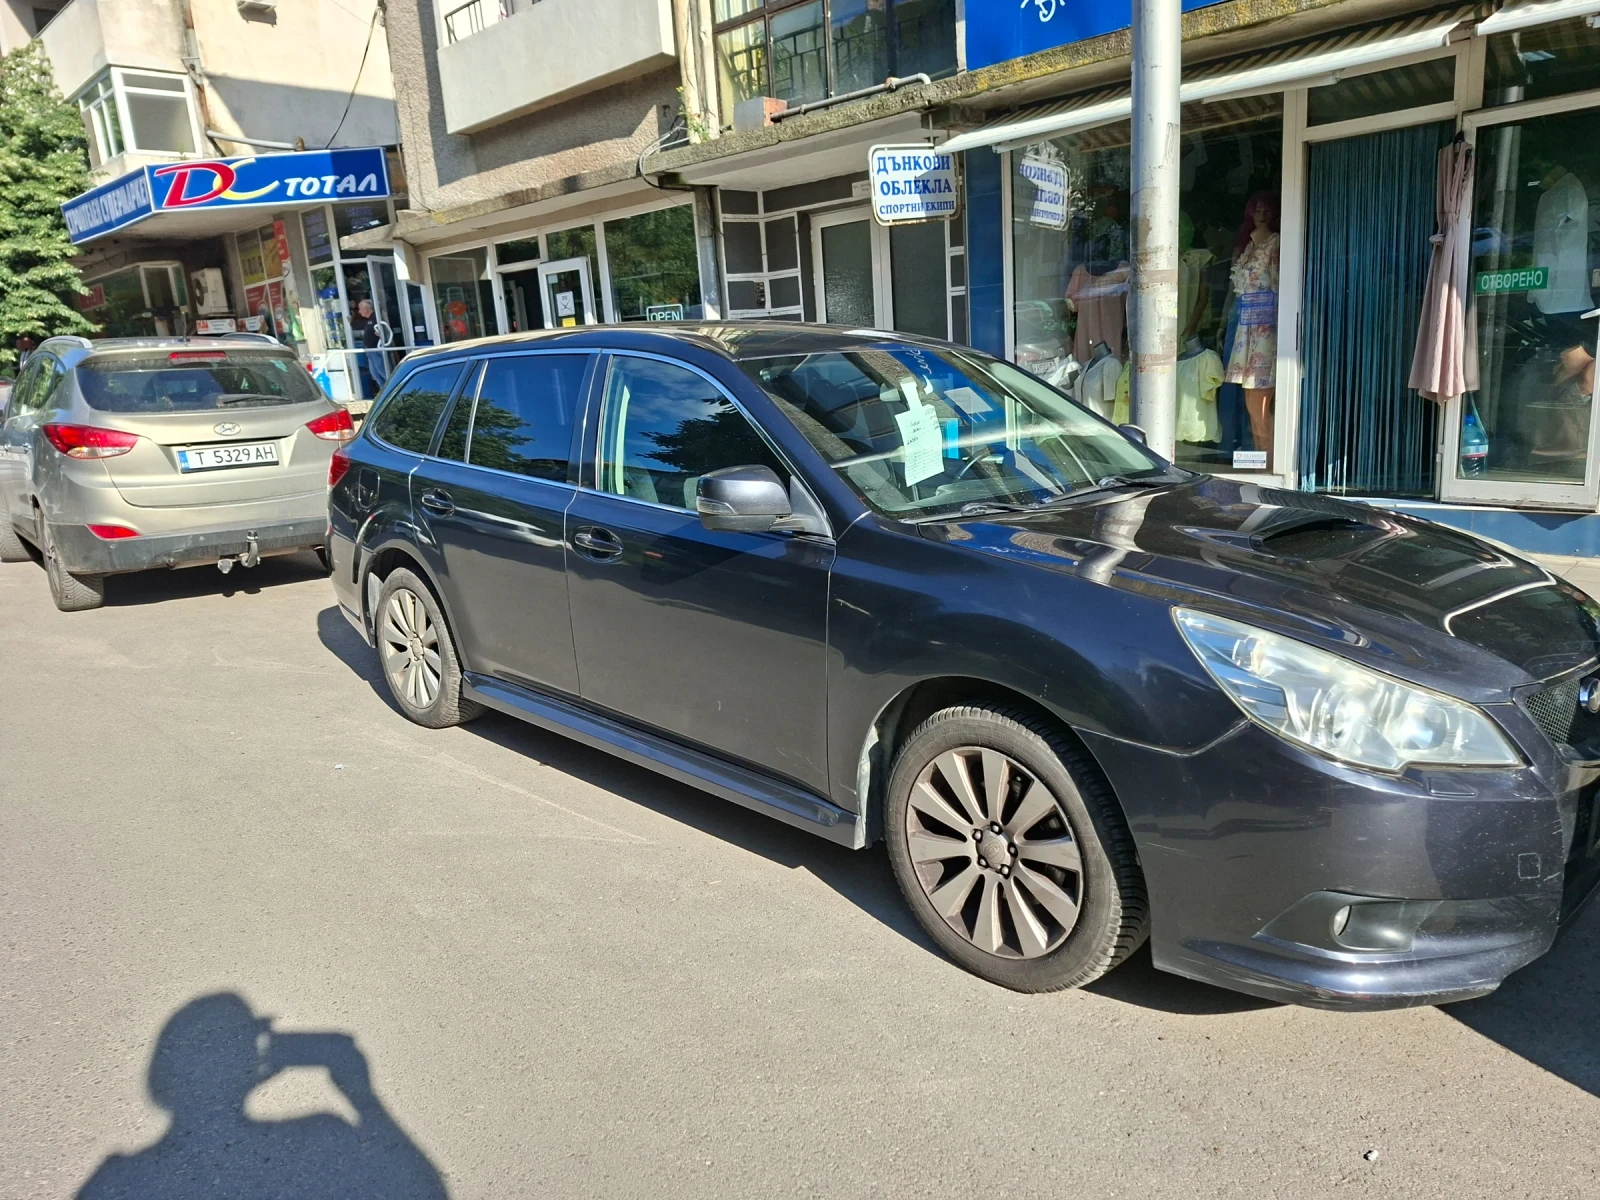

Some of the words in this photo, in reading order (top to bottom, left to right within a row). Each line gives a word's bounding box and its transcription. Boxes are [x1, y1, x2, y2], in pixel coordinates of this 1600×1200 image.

[877, 156, 951, 175] ДЪНКОВИ
[284, 173, 378, 197] ТОТАЛ
[880, 178, 952, 196] ОБЛЕКЛА
[879, 202, 924, 215] СПОРТНИ
[925, 200, 955, 212] ЕКИПИ
[1481, 270, 1543, 290] ОТВОРЕНО
[650, 311, 680, 321] OPEN
[195, 452, 205, 465] T
[213, 448, 250, 464] 5329
[255, 446, 274, 460] AH
